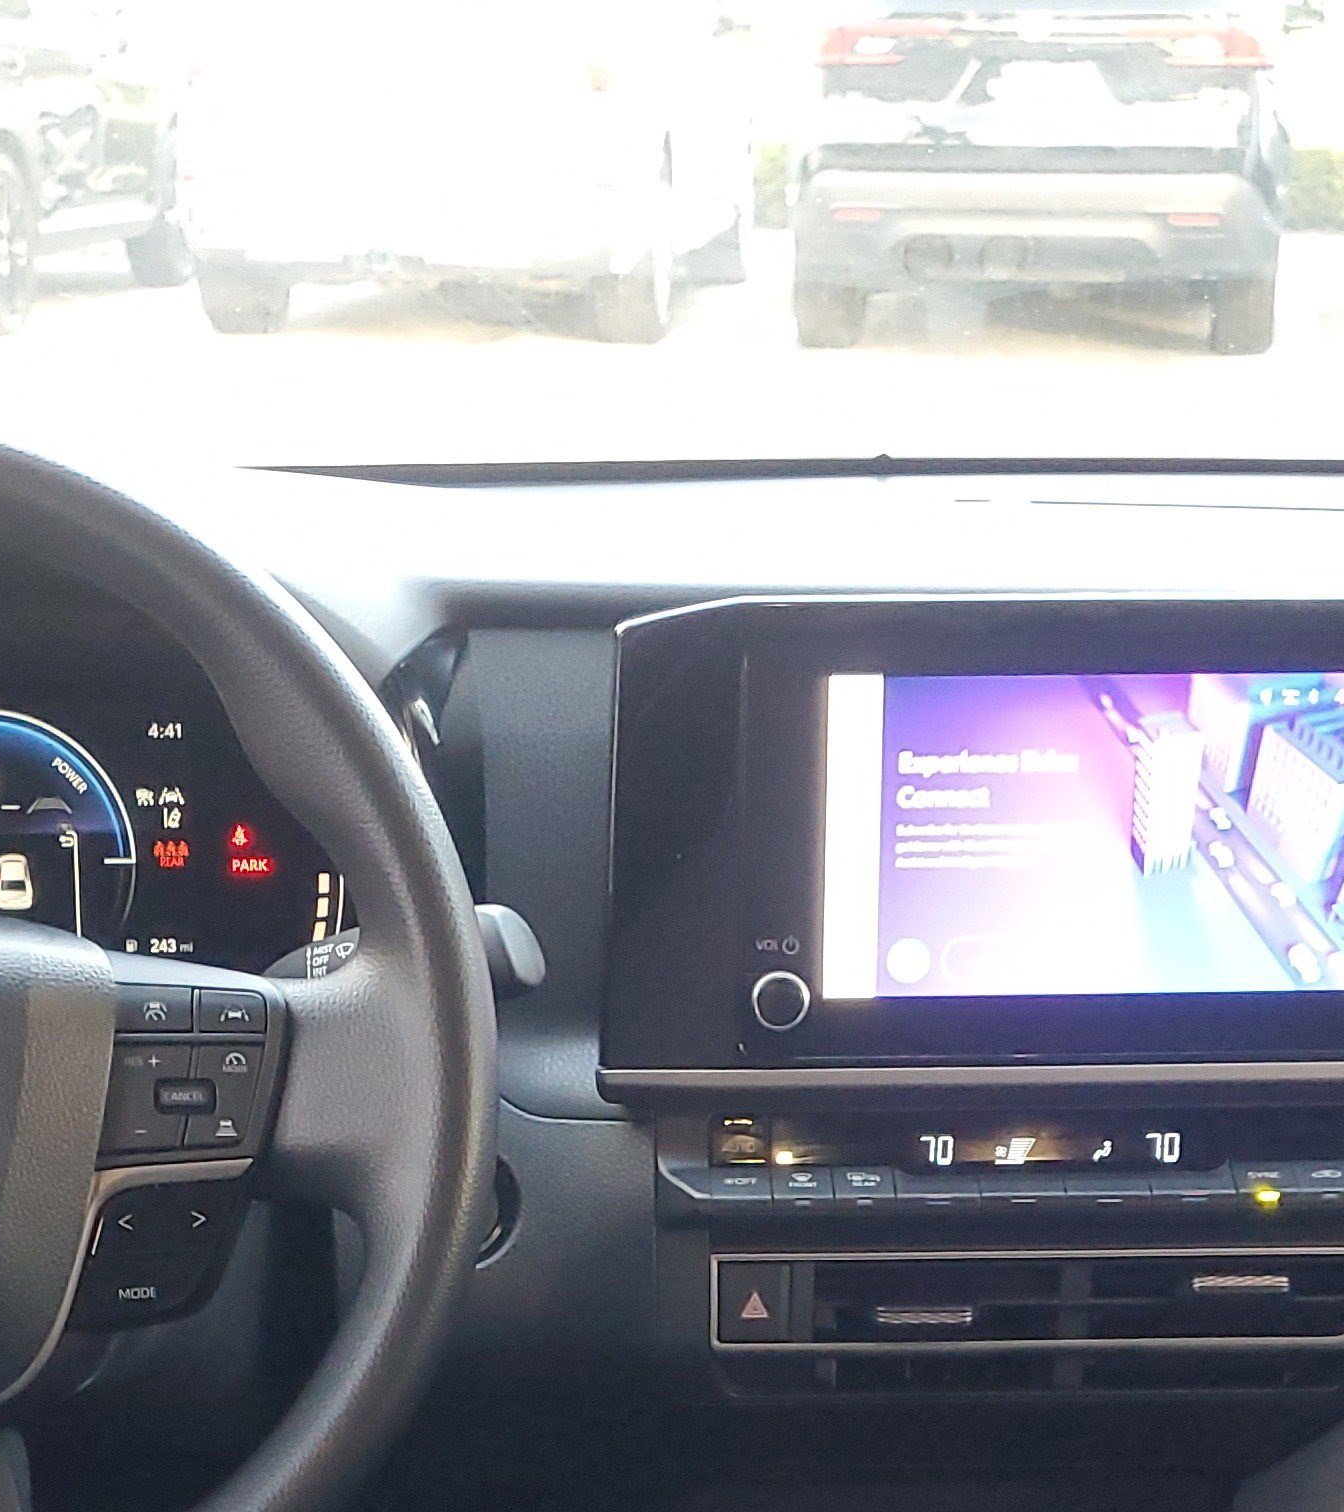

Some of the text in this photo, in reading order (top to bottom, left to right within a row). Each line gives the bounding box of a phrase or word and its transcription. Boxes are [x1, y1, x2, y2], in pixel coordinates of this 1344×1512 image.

[147, 722, 182, 739] 4:41
[51, 756, 88, 795] POWER
[231, 858, 271, 873] PARK
[149, 937, 177, 954] 243
[312, 955, 330, 967] OFF
[919, 1135, 954, 1166] 70
[1145, 1132, 1181, 1163] 70
